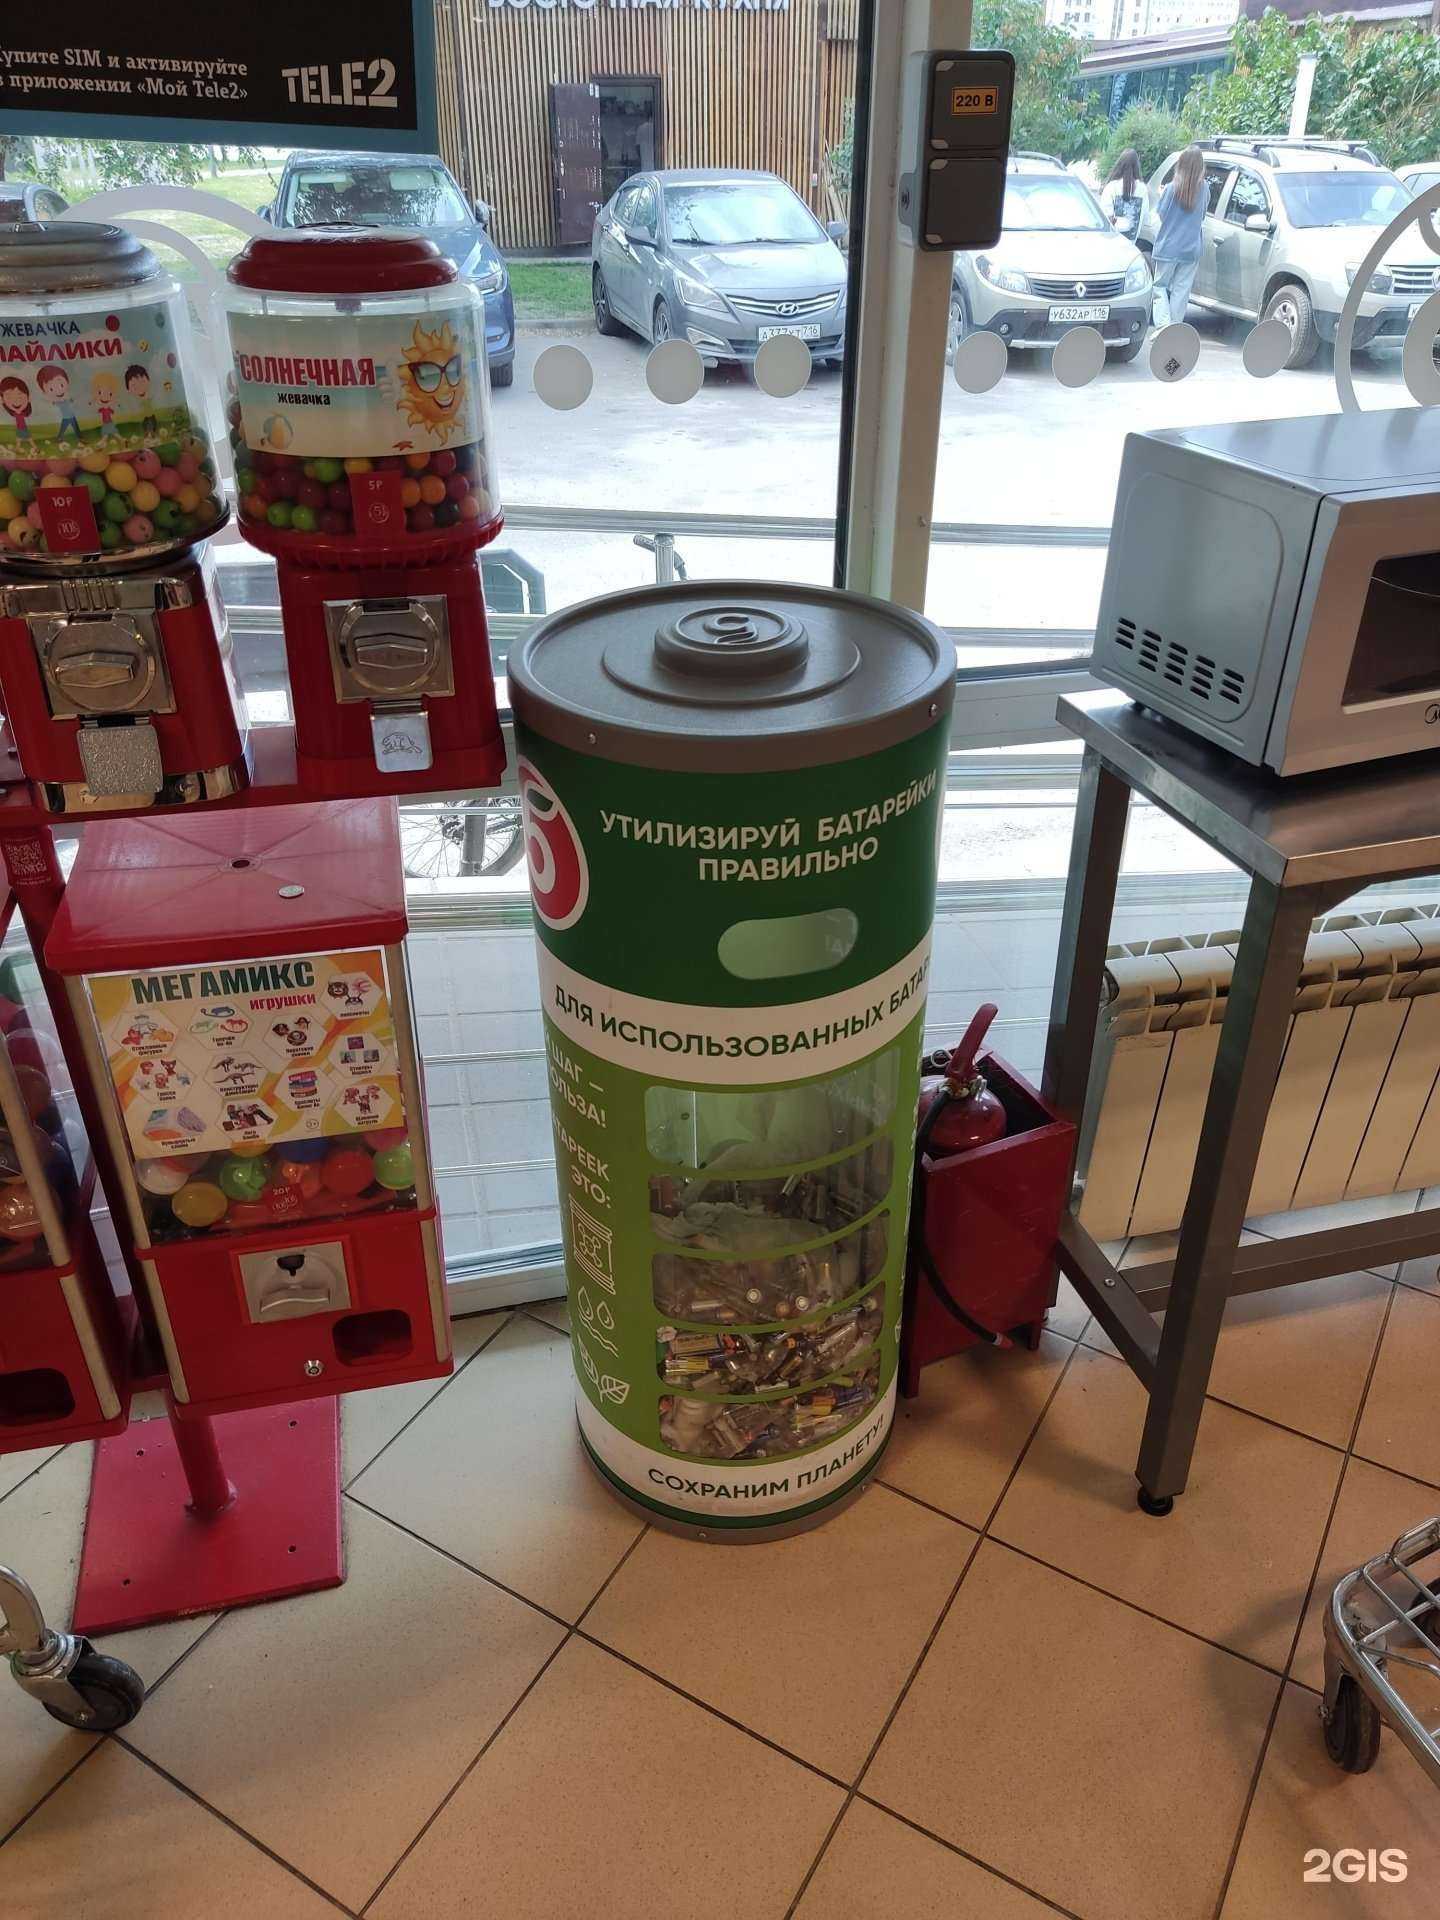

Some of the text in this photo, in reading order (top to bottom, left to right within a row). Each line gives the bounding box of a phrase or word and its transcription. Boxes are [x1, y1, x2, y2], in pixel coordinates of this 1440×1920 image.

[64, 48, 102, 68] SIM
[107, 55, 120, 68] и
[126, 57, 248, 79] активируйте
[281, 57, 399, 108] TELE2
[9, 75, 132, 93] приложении
[137, 77, 188, 97] «Мой
[192, 77, 249, 100] Tele2»
[956, 94, 981, 107] 220
[0, 320, 80, 337] ЖЕВАЧКА
[239, 353, 377, 388] СОЛНЕЧНАЯ
[277, 392, 331, 406] жевачка
[600, 768, 938, 850] УТИЛИЗИРУЙ БАТАРЕЙКИ
[698, 836, 879, 882] ПРАВИЛЬНО
[131, 961, 315, 1004] МЕГАМИКС
[249, 993, 316, 1011] игрушки
[555, 985, 595, 1027] ДЛЯ
[600, 1000, 885, 1058] ИСПОЛЬЗОВАННЫХ
[552, 1040, 583, 1083] ШАГ
[648, 1414, 885, 1499] СОХРАНИМ ПЛАНЕТУ!
